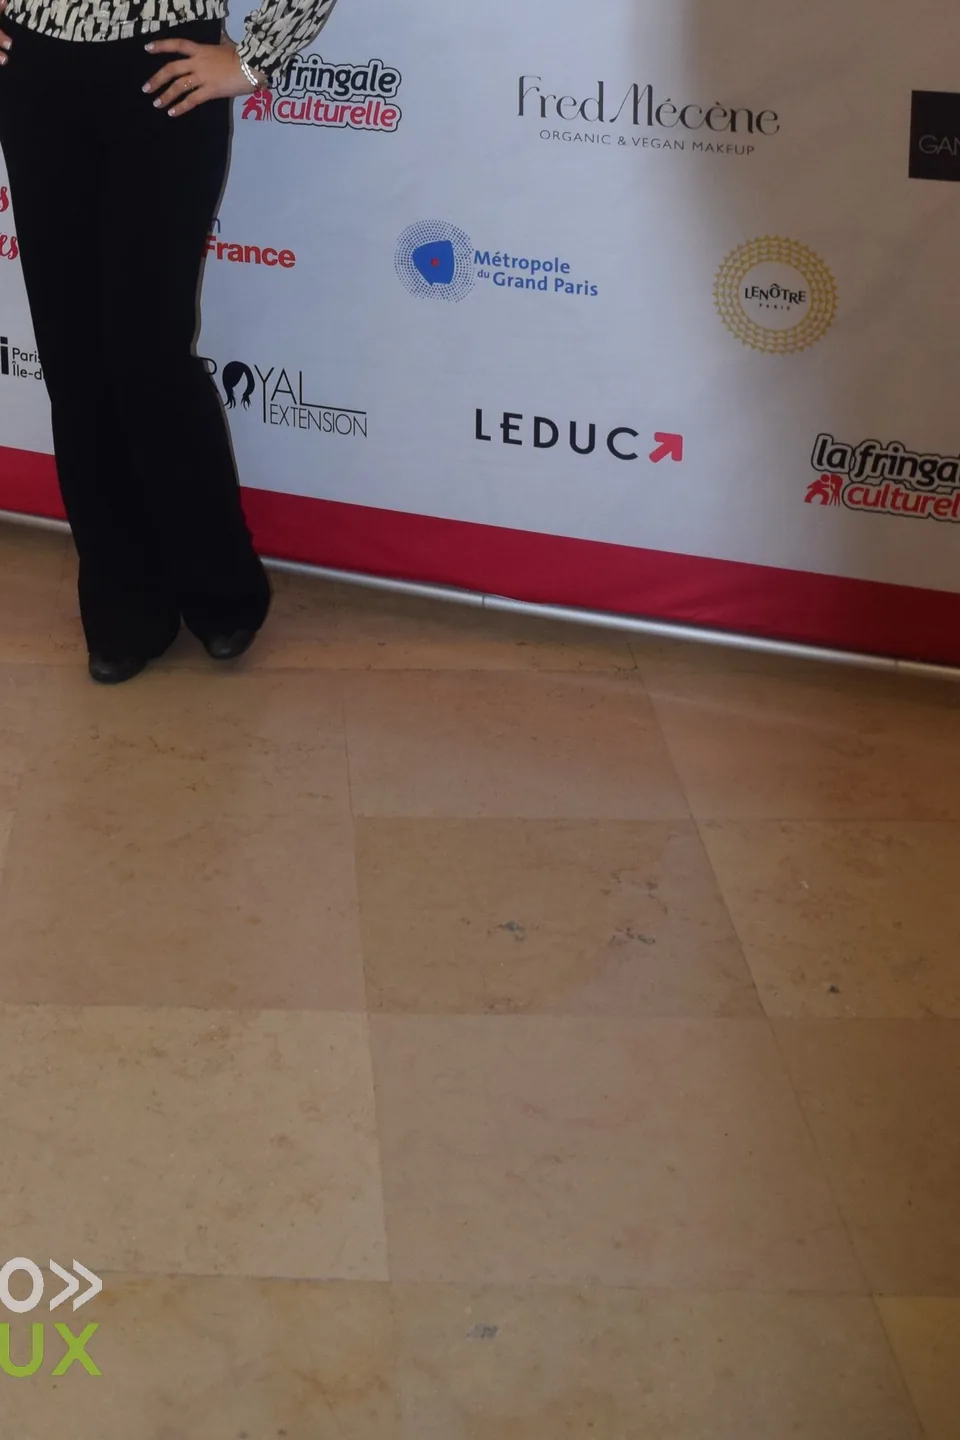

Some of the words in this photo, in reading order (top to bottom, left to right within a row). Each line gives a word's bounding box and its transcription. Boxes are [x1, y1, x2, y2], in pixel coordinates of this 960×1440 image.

[282, 58, 397, 97] fringale
[277, 95, 397, 128] culturelle
[518, 76, 604, 122] Fred
[610, 83, 779, 133] Mécène
[540, 130, 610, 144] ORGANIC
[618, 136, 626, 145] &
[632, 137, 684, 150] VEGAN
[692, 141, 754, 155] MAKEUP
[474, 250, 570, 278] Métropole
[477, 269, 489, 278] du
[493, 272, 547, 291] Grand
[555, 278, 598, 296] Paris
[745, 283, 805, 304] LENÔTRE
[270, 403, 367, 438] EXTENSION
[476, 409, 638, 460] LEDUC
[817, 439, 848, 469] la
